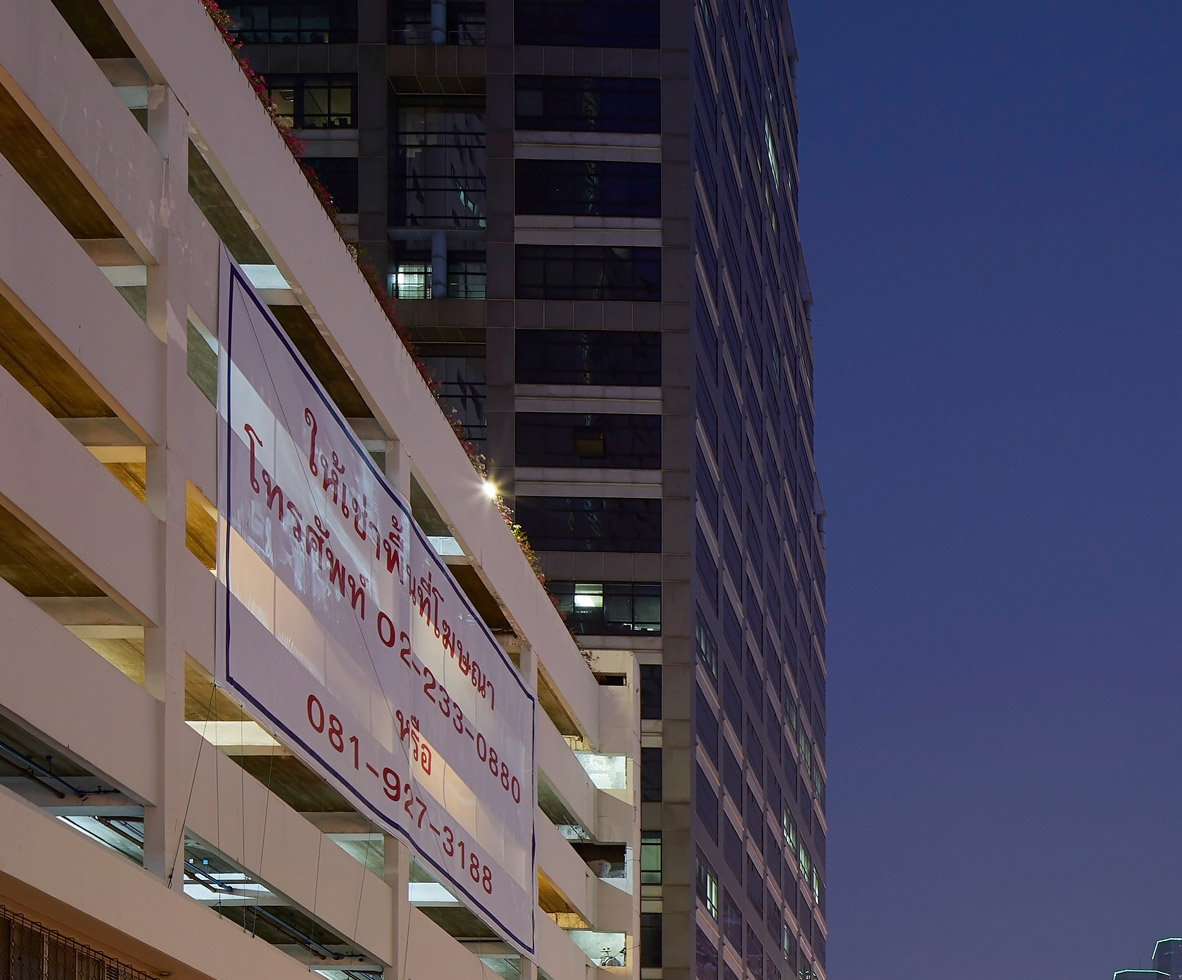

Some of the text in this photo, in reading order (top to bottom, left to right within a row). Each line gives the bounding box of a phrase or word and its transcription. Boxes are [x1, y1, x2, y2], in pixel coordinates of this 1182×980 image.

[243, 422, 521, 805] โทรศัพท์ 02-233-0880
[306, 693, 493, 895] 081-927-3188
[395, 709, 432, 776] หรือ
